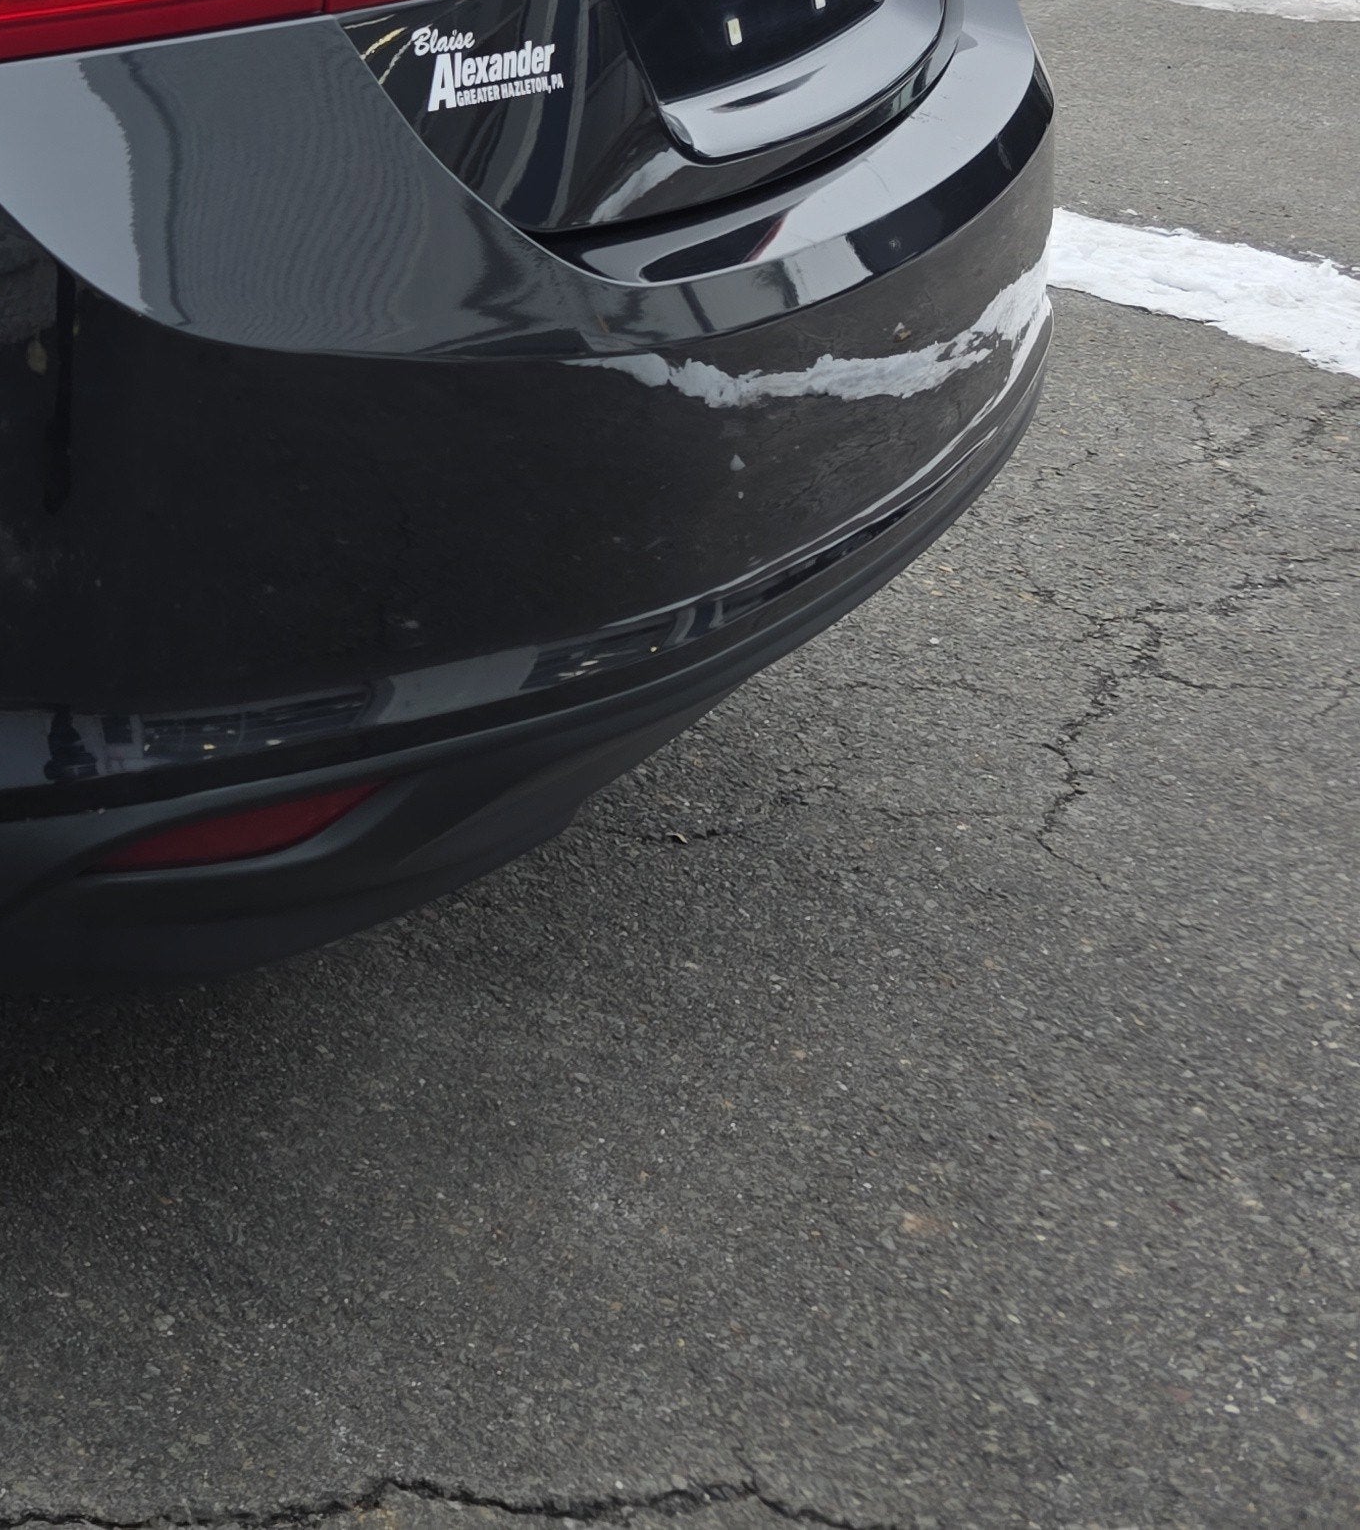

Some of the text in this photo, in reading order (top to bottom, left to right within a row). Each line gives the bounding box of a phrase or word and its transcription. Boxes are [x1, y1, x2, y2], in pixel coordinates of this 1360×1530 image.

[411, 23, 476, 57] Blaise
[428, 40, 555, 112] Alexander
[456, 84, 500, 107] GREATER
